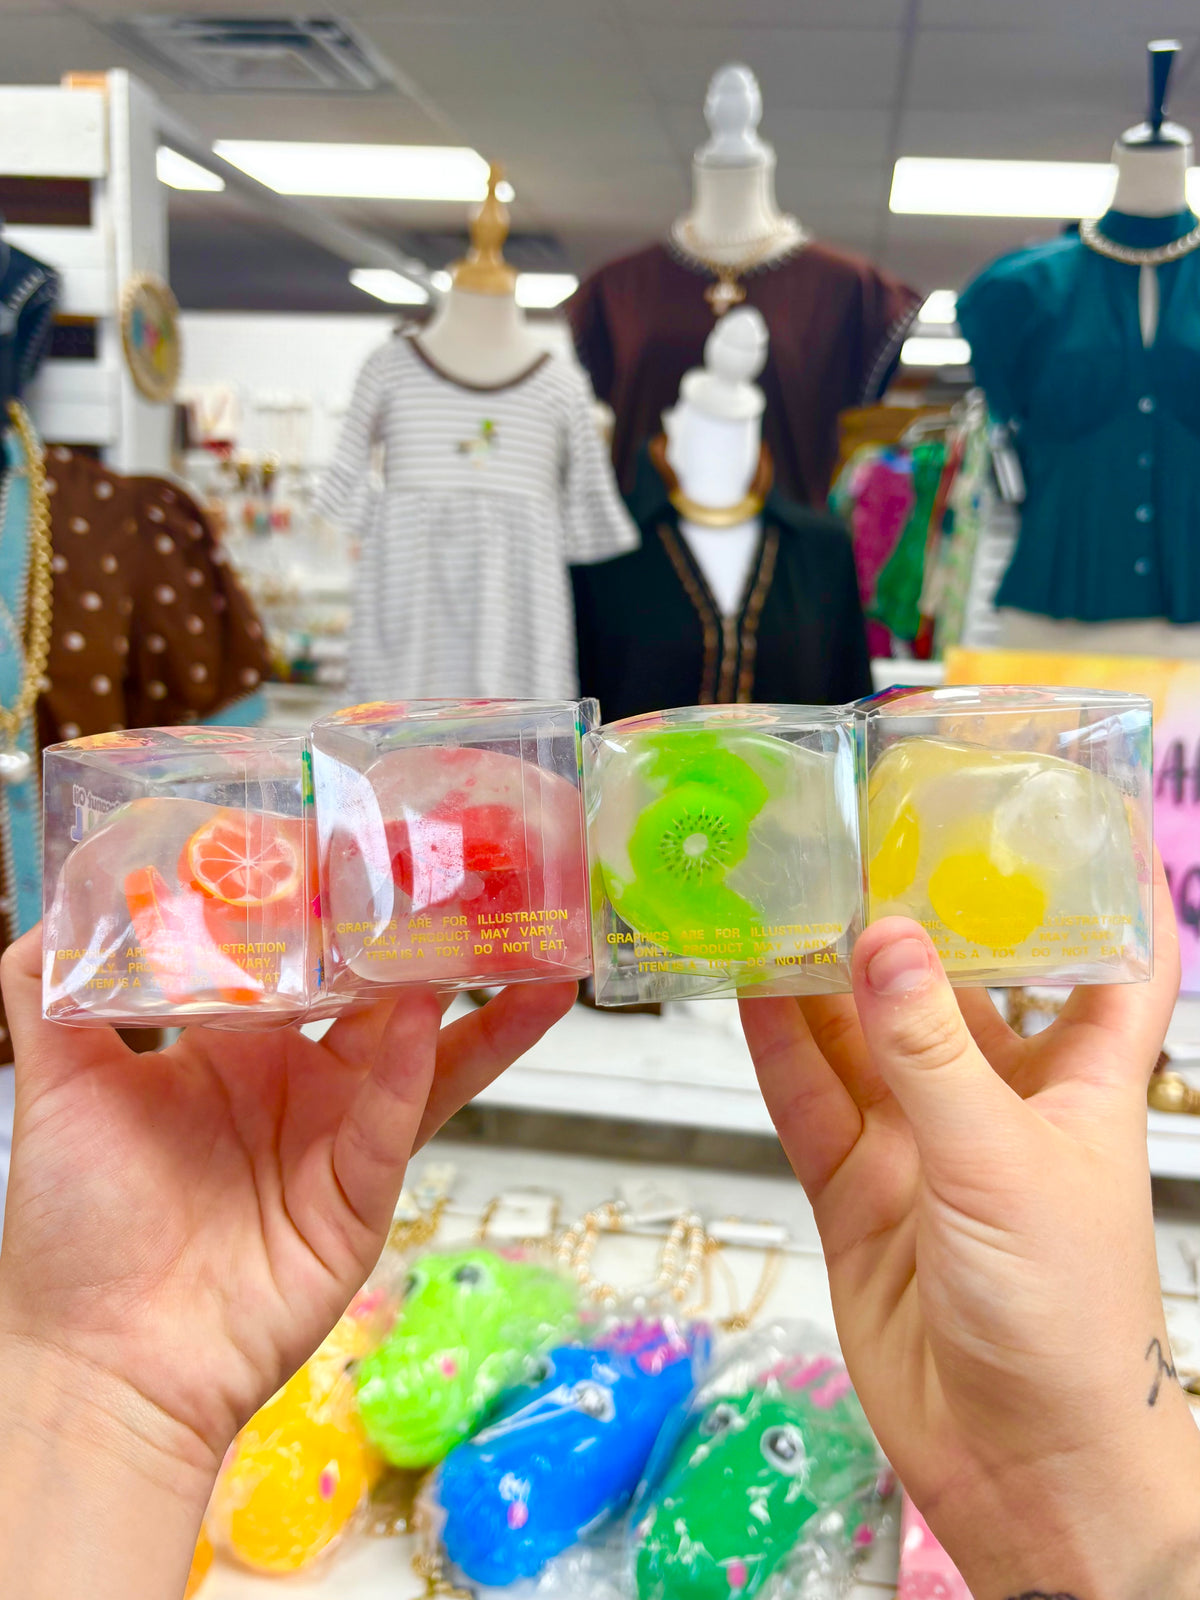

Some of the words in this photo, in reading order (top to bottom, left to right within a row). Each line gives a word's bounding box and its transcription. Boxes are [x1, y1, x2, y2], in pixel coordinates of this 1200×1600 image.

[336, 919, 398, 934] GRAPHS
[408, 917, 432, 929] ARE
[442, 916, 468, 927] FOR
[477, 909, 568, 925] ILLUSTRATION
[411, 930, 471, 944] PRODUCT
[481, 927, 509, 940] MAY
[520, 925, 558, 937] VARY.
[606, 930, 670, 944] GRAPHICS
[680, 929, 704, 940] ARE
[715, 927, 740, 939] FOR
[750, 922, 843, 937] ILLUSTRATION
[473, 944, 493, 955] DO
[503, 941, 530, 953] NOT
[682, 942, 743, 955] PRODUCT
[753, 940, 783, 953] MAY
[1031, 947, 1051, 957] DO
[1062, 945, 1089, 957] NOT
[746, 956, 766, 968] DO
[776, 955, 803, 966] NOT
